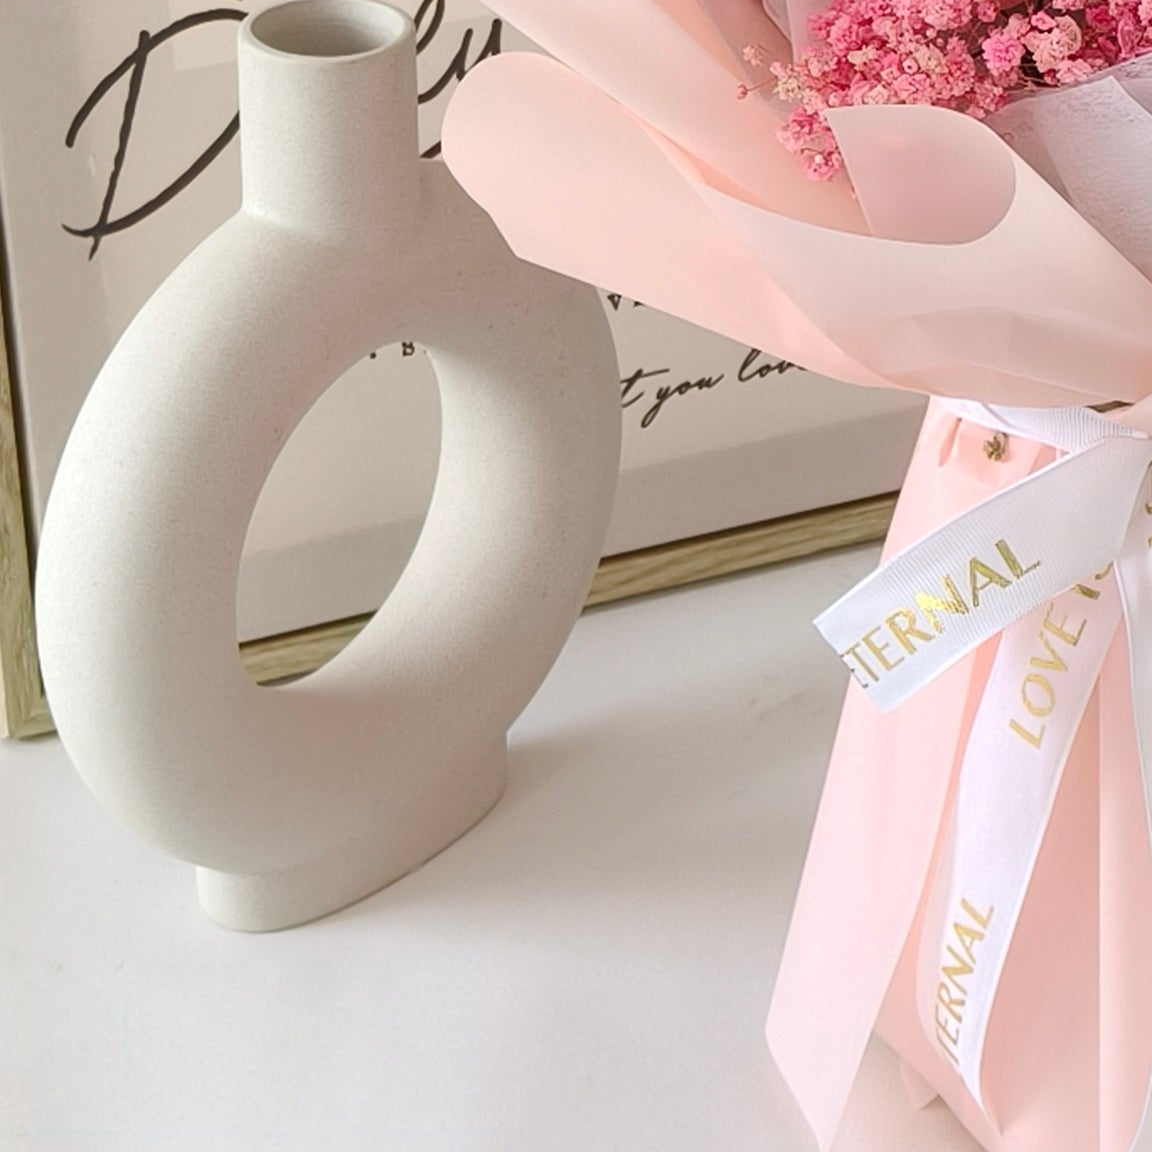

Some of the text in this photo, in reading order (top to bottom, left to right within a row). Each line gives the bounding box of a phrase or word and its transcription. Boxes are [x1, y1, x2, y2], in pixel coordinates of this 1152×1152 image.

[640, 373, 724, 429] you
[737, 348, 808, 383] lov
[840, 538, 1041, 689] TERNAL
[1008, 600, 1087, 750] LOVE
[935, 897, 995, 1067] TERNAL
